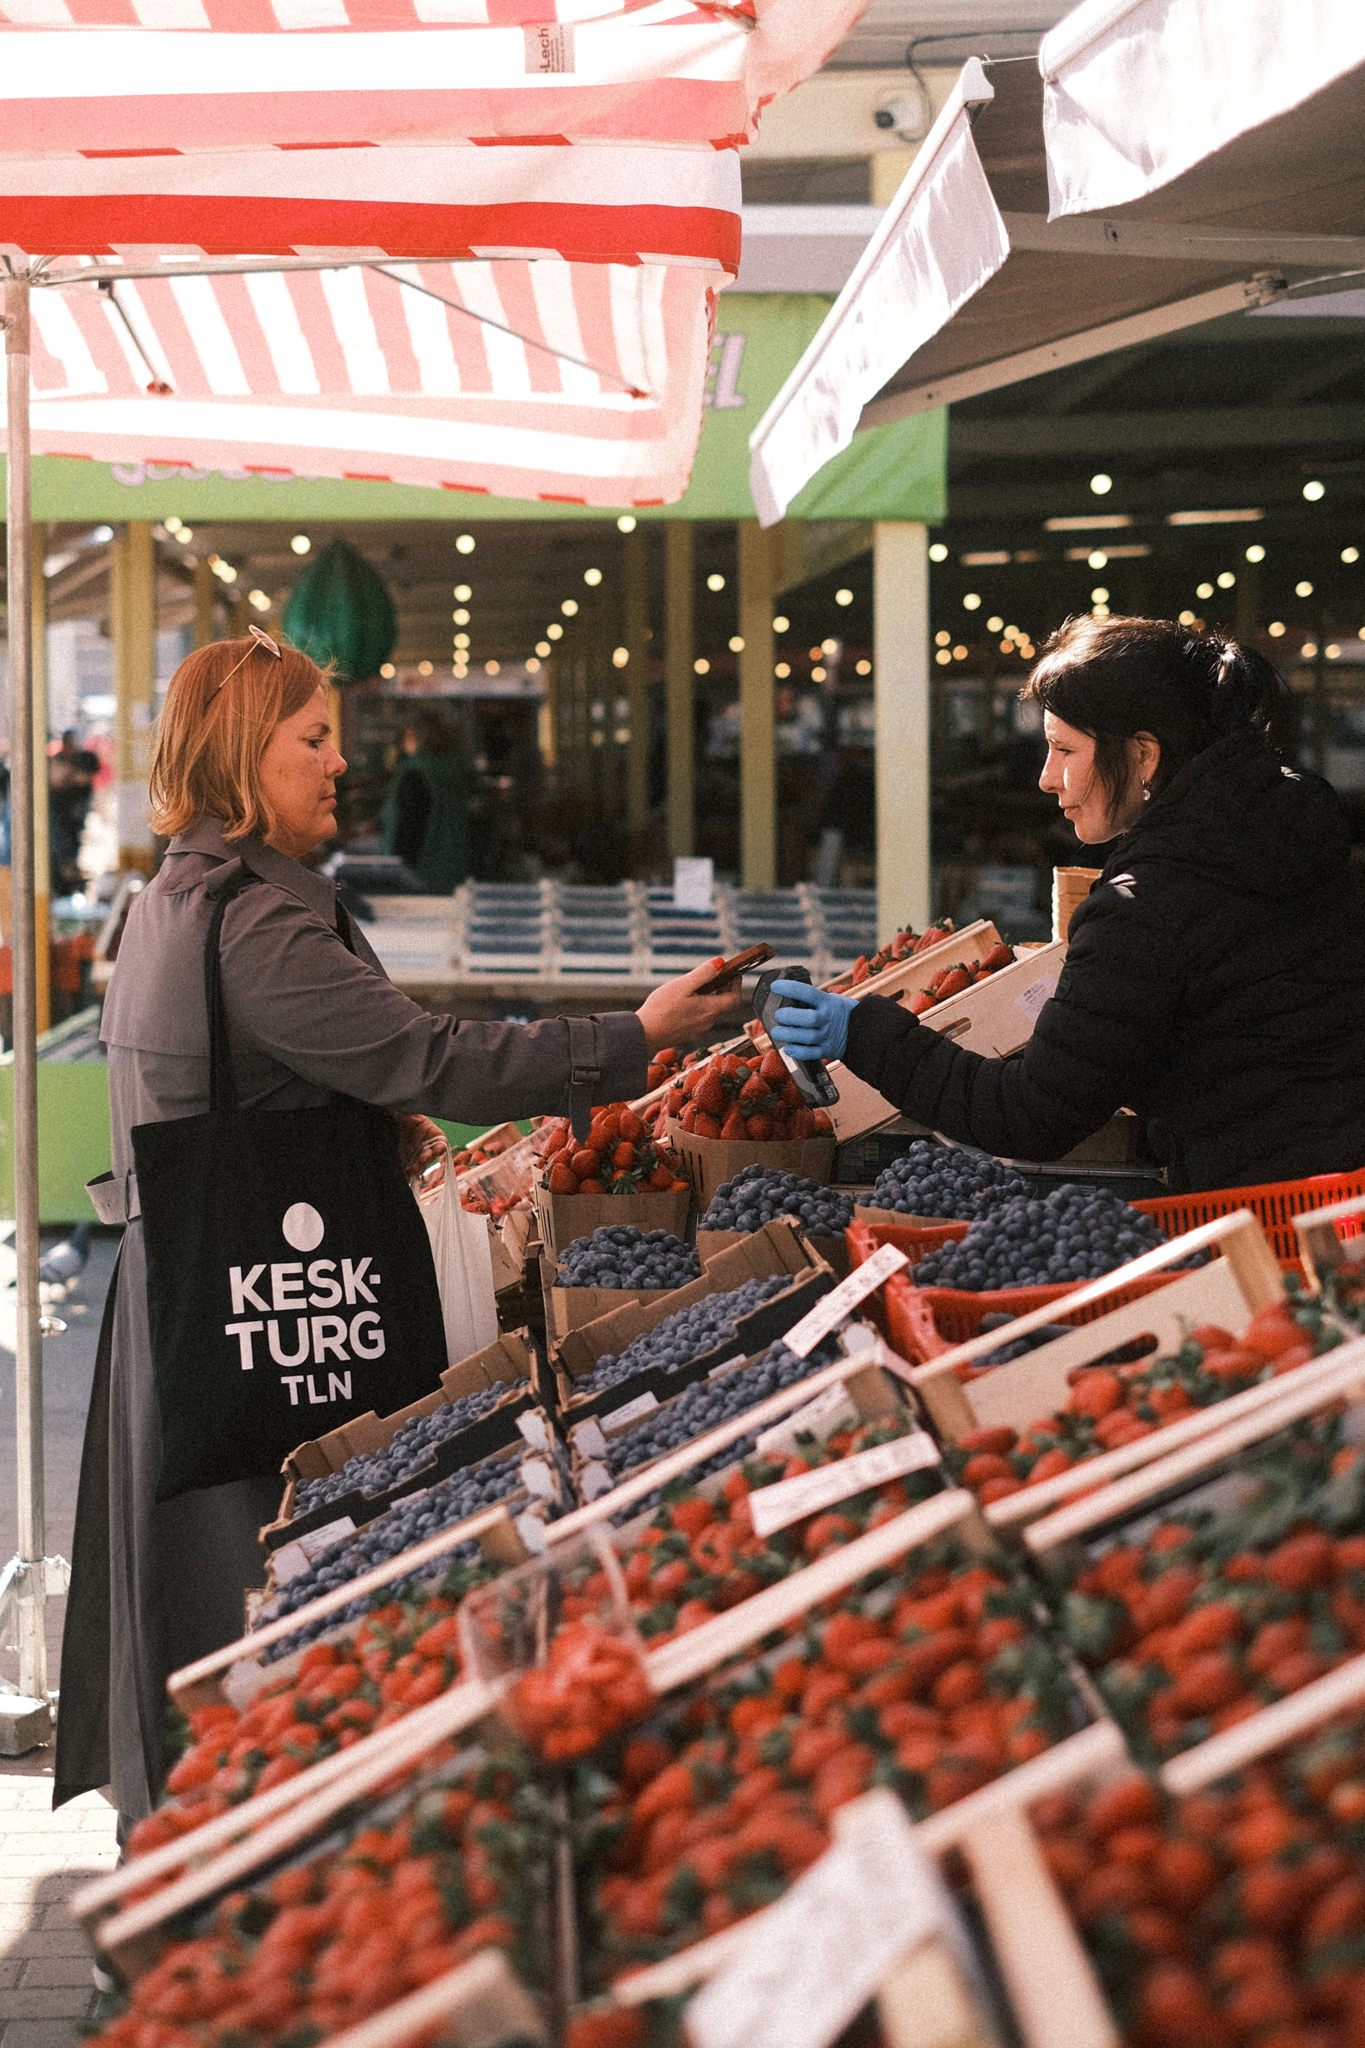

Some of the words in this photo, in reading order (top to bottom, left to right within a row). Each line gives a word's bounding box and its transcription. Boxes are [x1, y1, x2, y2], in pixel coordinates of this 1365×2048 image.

[229, 1257, 381, 1314] KESK-
[225, 1311, 386, 1370] TURG
[280, 1370, 352, 1405] TLN
